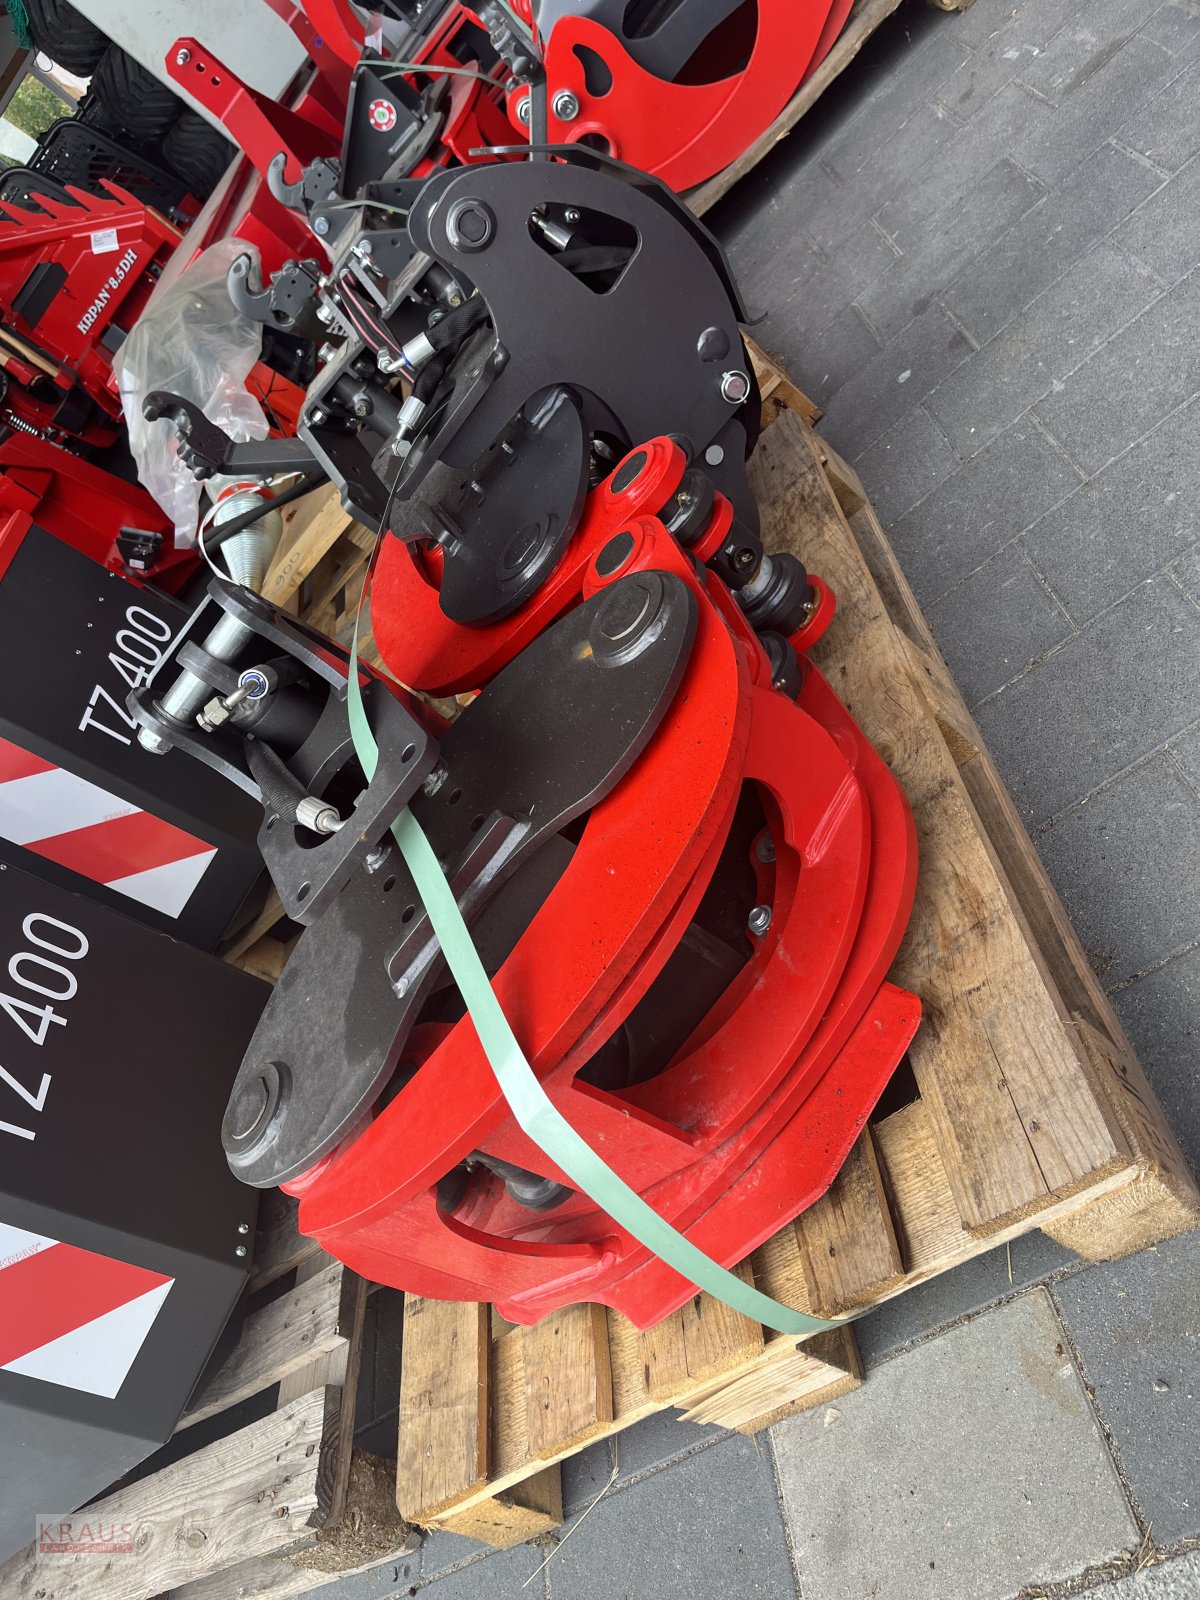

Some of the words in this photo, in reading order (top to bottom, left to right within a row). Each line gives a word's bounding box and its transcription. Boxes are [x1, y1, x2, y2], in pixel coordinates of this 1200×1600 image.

[78, 684, 138, 746] TZ
[108, 605, 172, 690] 400
[0, 912, 90, 1046] 400
